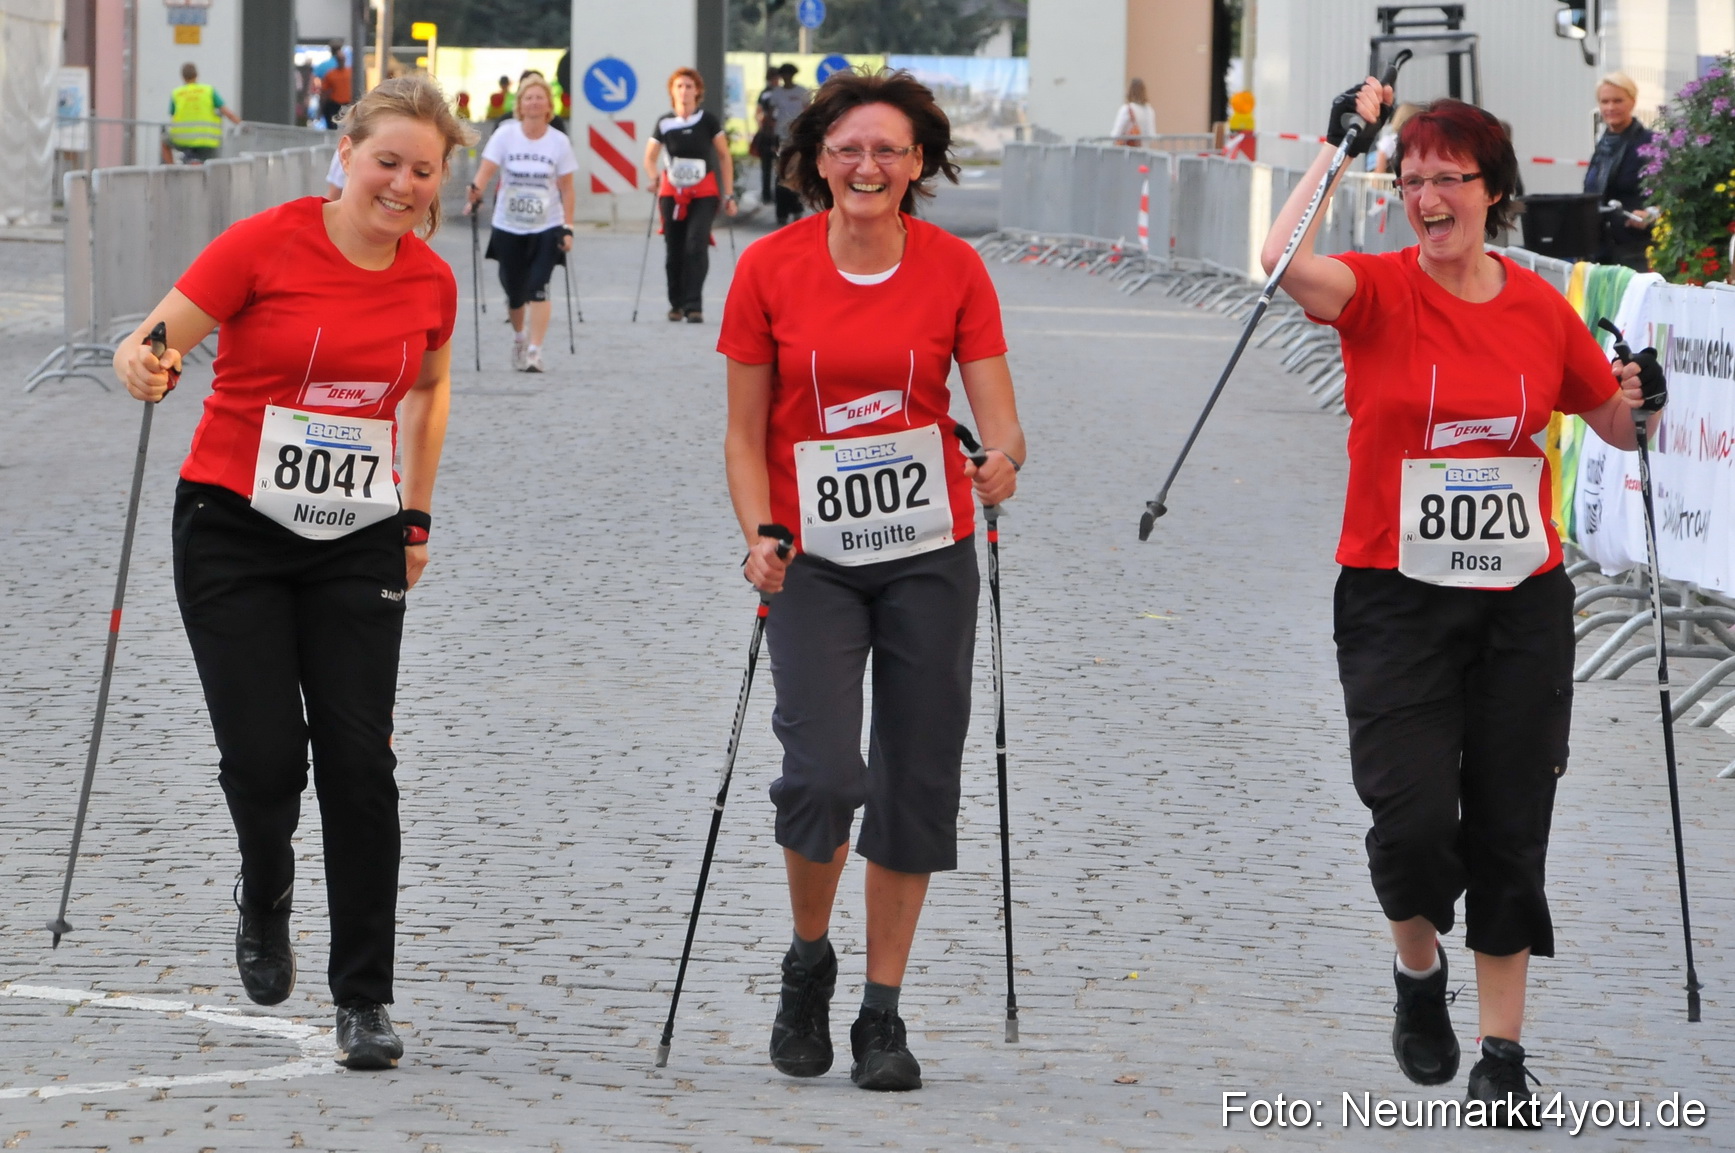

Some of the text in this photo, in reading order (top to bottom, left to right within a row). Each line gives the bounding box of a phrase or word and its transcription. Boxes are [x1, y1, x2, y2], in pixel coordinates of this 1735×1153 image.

[508, 198, 543, 214] 8063
[327, 388, 366, 400] DEHN
[847, 399, 881, 420] DEHN
[306, 422, 362, 441] BOCK
[1454, 425, 1492, 438] DEHN
[834, 442, 897, 463] BOCK
[274, 444, 380, 498] 8047
[1445, 467, 1500, 483] BOCK
[816, 462, 930, 522] 8002
[293, 503, 356, 527] Nicole
[1419, 492, 1530, 541] 8020
[841, 524, 916, 551] Brigitte
[1451, 551, 1502, 571] Rosa
